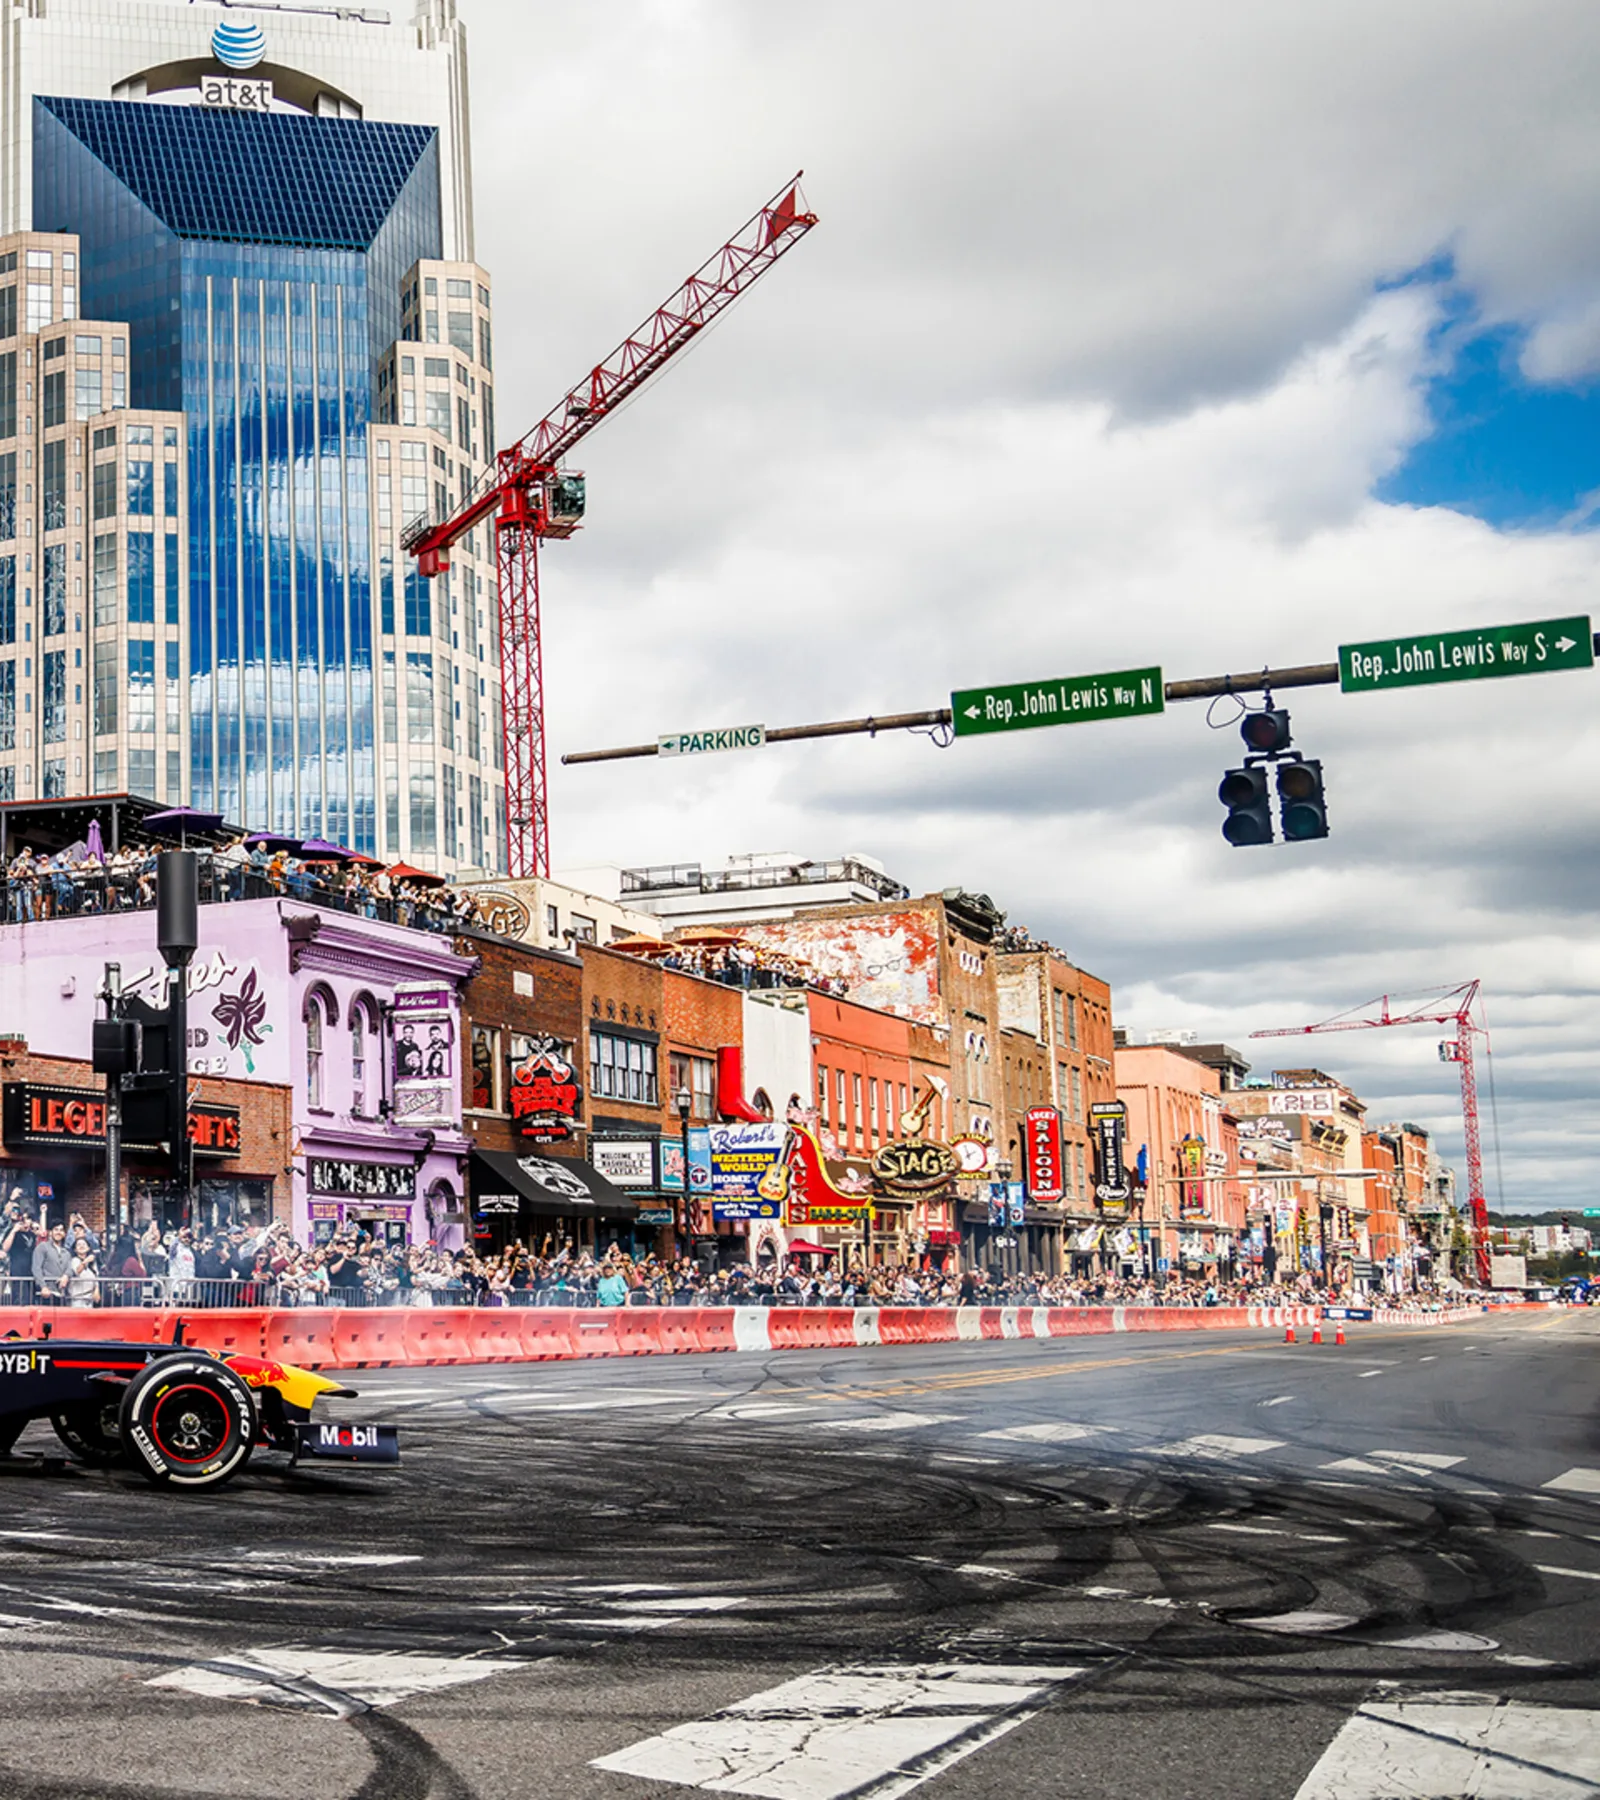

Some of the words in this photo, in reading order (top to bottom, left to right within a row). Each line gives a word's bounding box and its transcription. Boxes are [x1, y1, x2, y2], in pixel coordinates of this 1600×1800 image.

[206, 79, 270, 108] at&t
[1351, 651, 1389, 682] Rep.
[1392, 645, 1435, 674] John
[1440, 636, 1496, 669] Lewis
[1501, 641, 1528, 664] Way
[1534, 632, 1547, 661] S
[985, 695, 1018, 723] Rep.
[1020, 689, 1057, 716] John
[1061, 682, 1108, 711] Lewis
[1113, 687, 1136, 707] Way
[1141, 678, 1153, 704] N
[680, 727, 761, 752] PARKING
[510, 1085, 577, 1102] SECOND
[31, 1098, 107, 1138] LEGE
[714, 1125, 775, 1153] Robert's
[1102, 1119, 1116, 1186] WHISKEY
[712, 1153, 775, 1163] WESTERN
[720, 1163, 766, 1172] WORLD
[877, 1146, 956, 1179] STAGE
[1034, 1121, 1053, 1190] SALOON
[713, 1175, 750, 1184] HOME
[195, 1365, 213, 1375] P
[217, 1375, 250, 1438] ZERO
[130, 1425, 168, 1475] PIRELLI
[320, 1425, 378, 1447] Mobil
